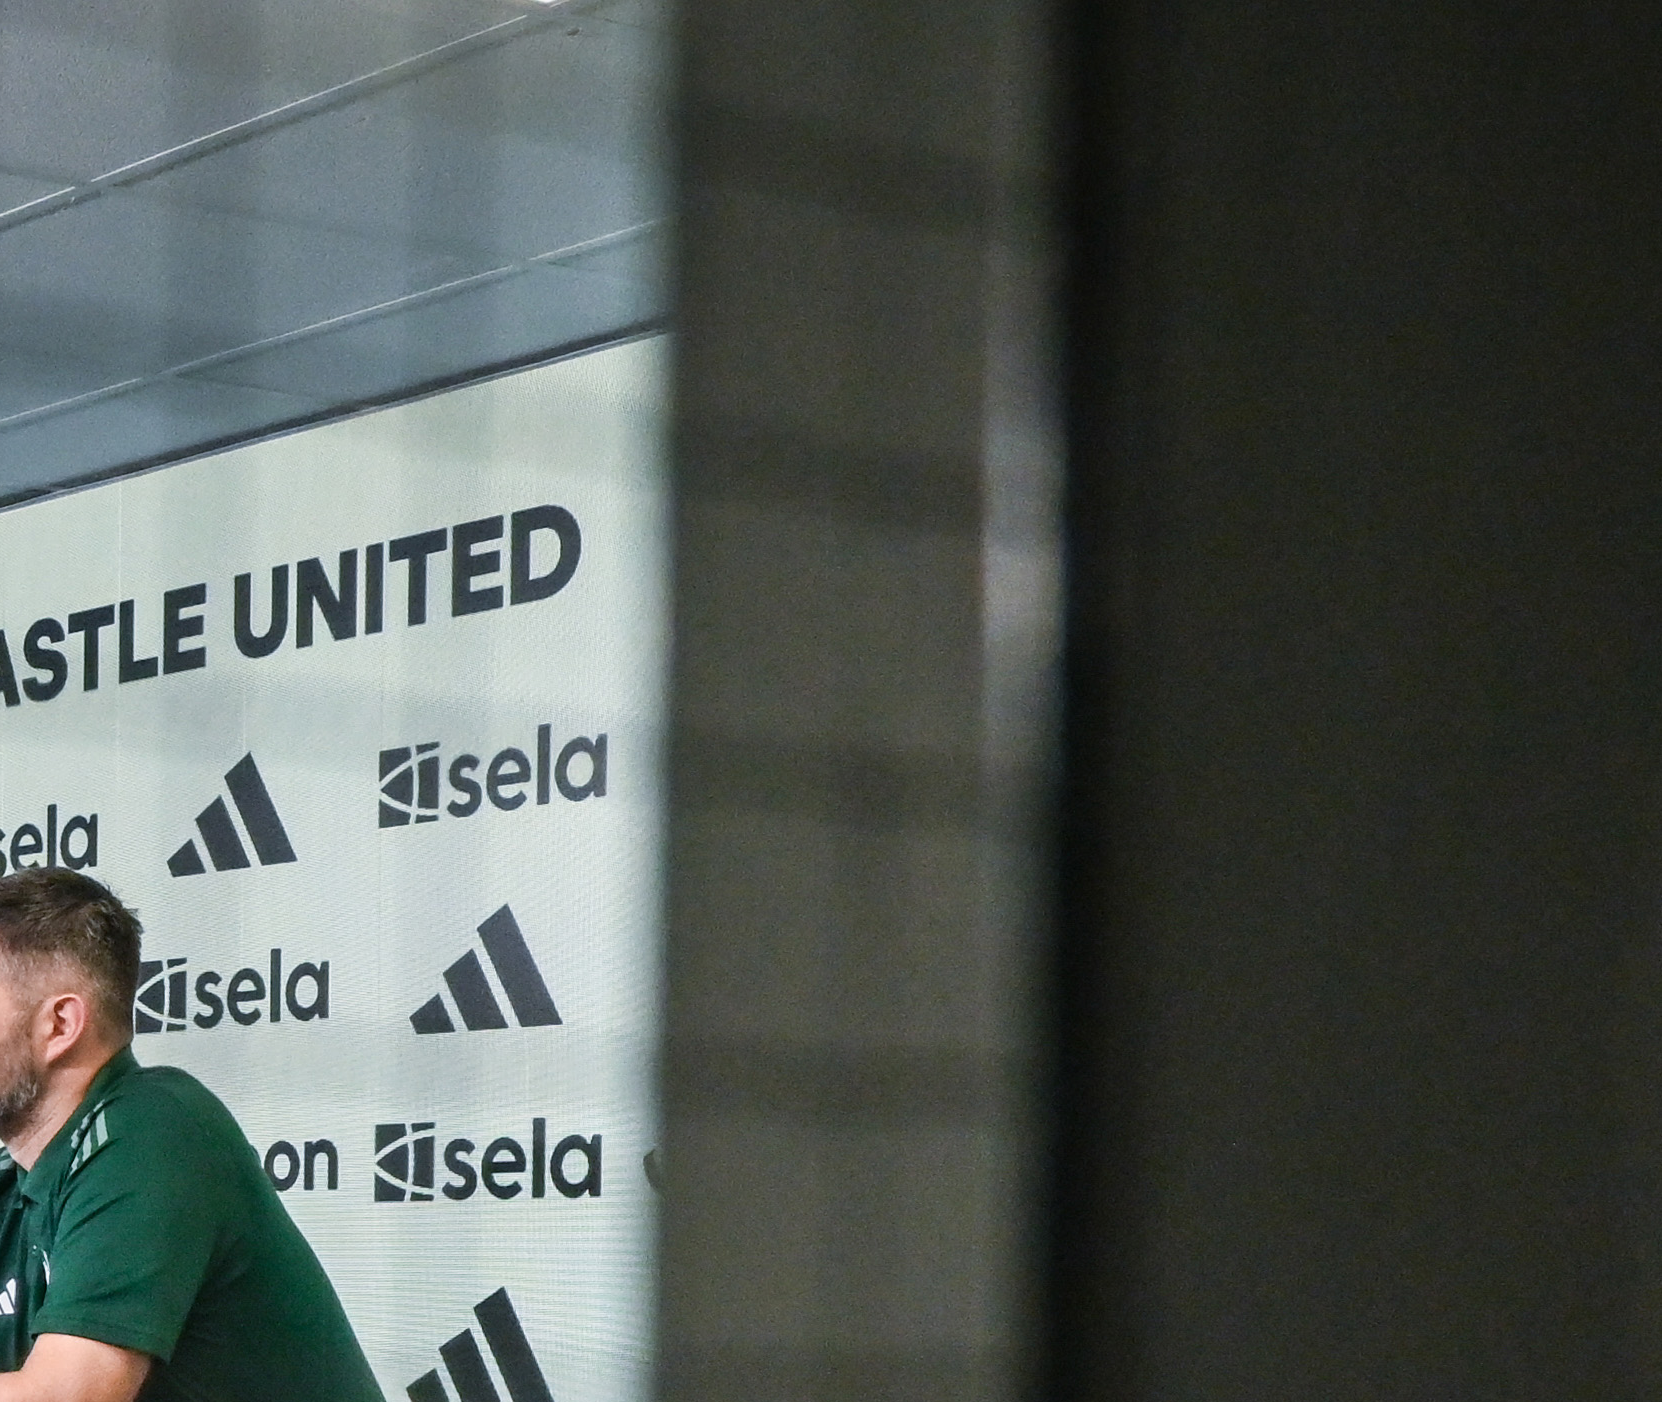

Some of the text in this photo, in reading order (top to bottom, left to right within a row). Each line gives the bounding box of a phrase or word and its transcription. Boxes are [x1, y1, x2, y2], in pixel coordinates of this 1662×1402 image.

[233, 504, 582, 659] UNITED
[445, 723, 608, 818] sela
[193, 948, 330, 1029] sela
[441, 1117, 602, 1200] sela
